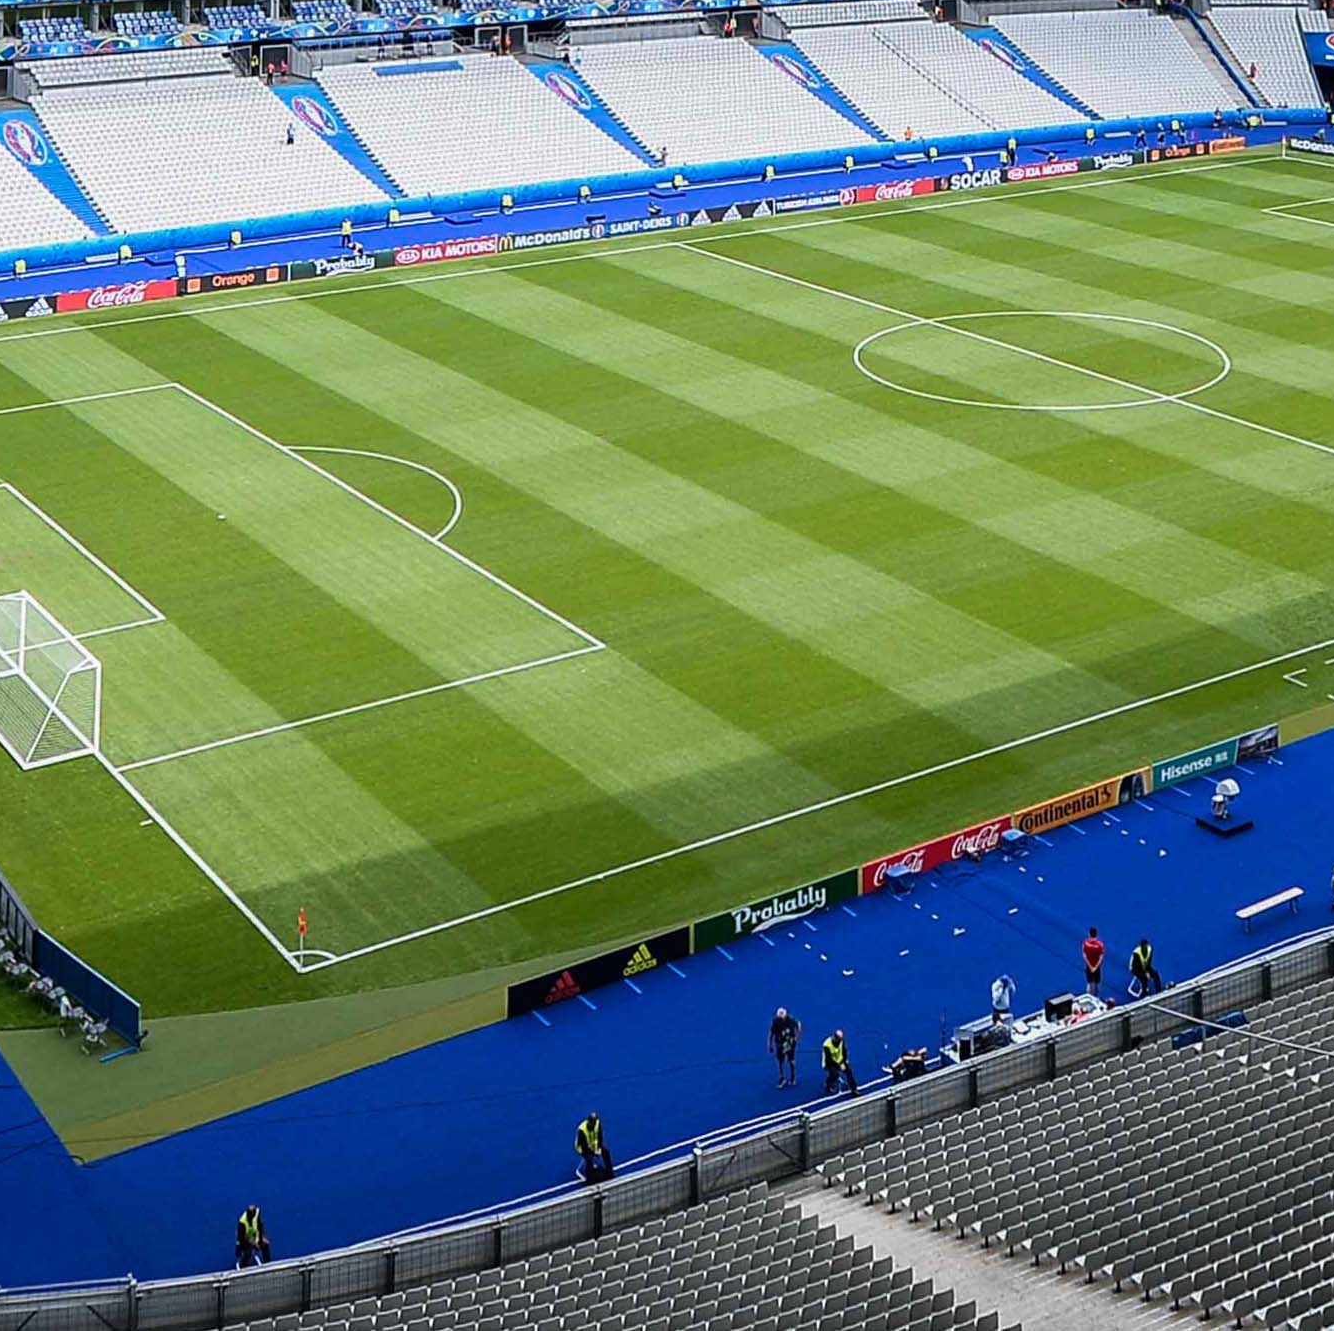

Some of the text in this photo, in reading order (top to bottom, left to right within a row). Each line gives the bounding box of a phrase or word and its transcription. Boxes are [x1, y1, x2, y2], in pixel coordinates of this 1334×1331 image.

[1094, 152, 1133, 168] Probably
[1165, 147, 1190, 157] Orange
[950, 168, 1002, 190] SOCAR
[1025, 161, 1079, 178] KIA MOTORS
[776, 196, 839, 211] TURKISH AIRLINES
[609, 216, 672, 236] SAINT-DENIS
[513, 226, 592, 248] McDonald's
[421, 239, 496, 261] KIA MOTORS
[315, 254, 375, 274] Probably
[212, 273, 255, 288] Orange
[1160, 755, 1213, 782] Hisense
[1019, 789, 1100, 835] Continental
[951, 823, 1001, 859] Coca-Cola
[731, 885, 827, 933] Probably
[623, 958, 658, 977] adidas
